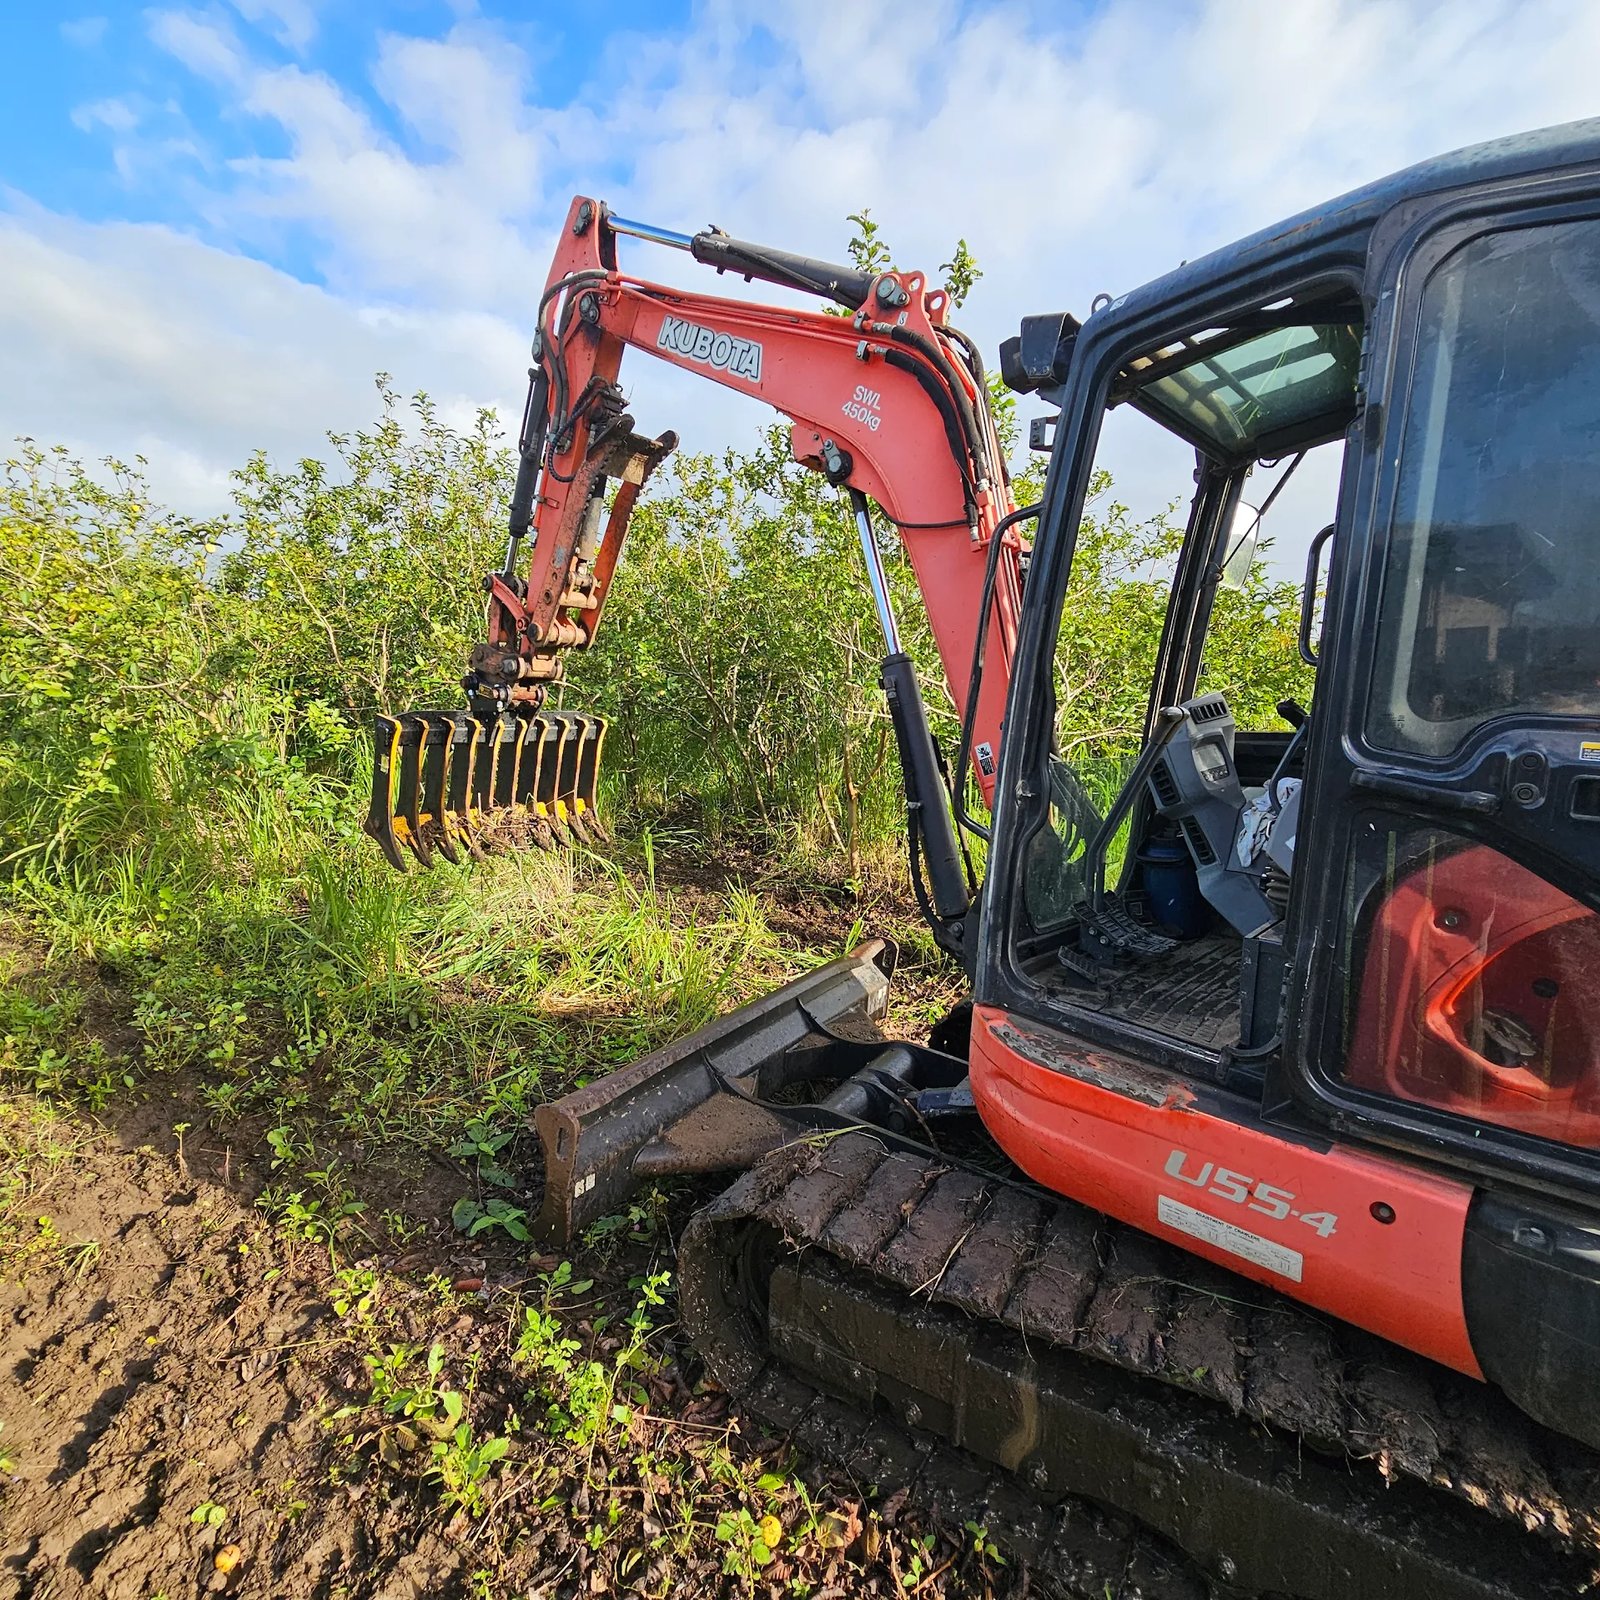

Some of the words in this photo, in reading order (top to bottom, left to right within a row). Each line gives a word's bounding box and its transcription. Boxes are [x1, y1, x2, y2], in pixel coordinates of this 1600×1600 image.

[658, 315, 762, 380] KUBOTA
[841, 401, 882, 432] 450kg
[853, 385, 881, 411] SWL
[1164, 1149, 1339, 1239] U55-4
